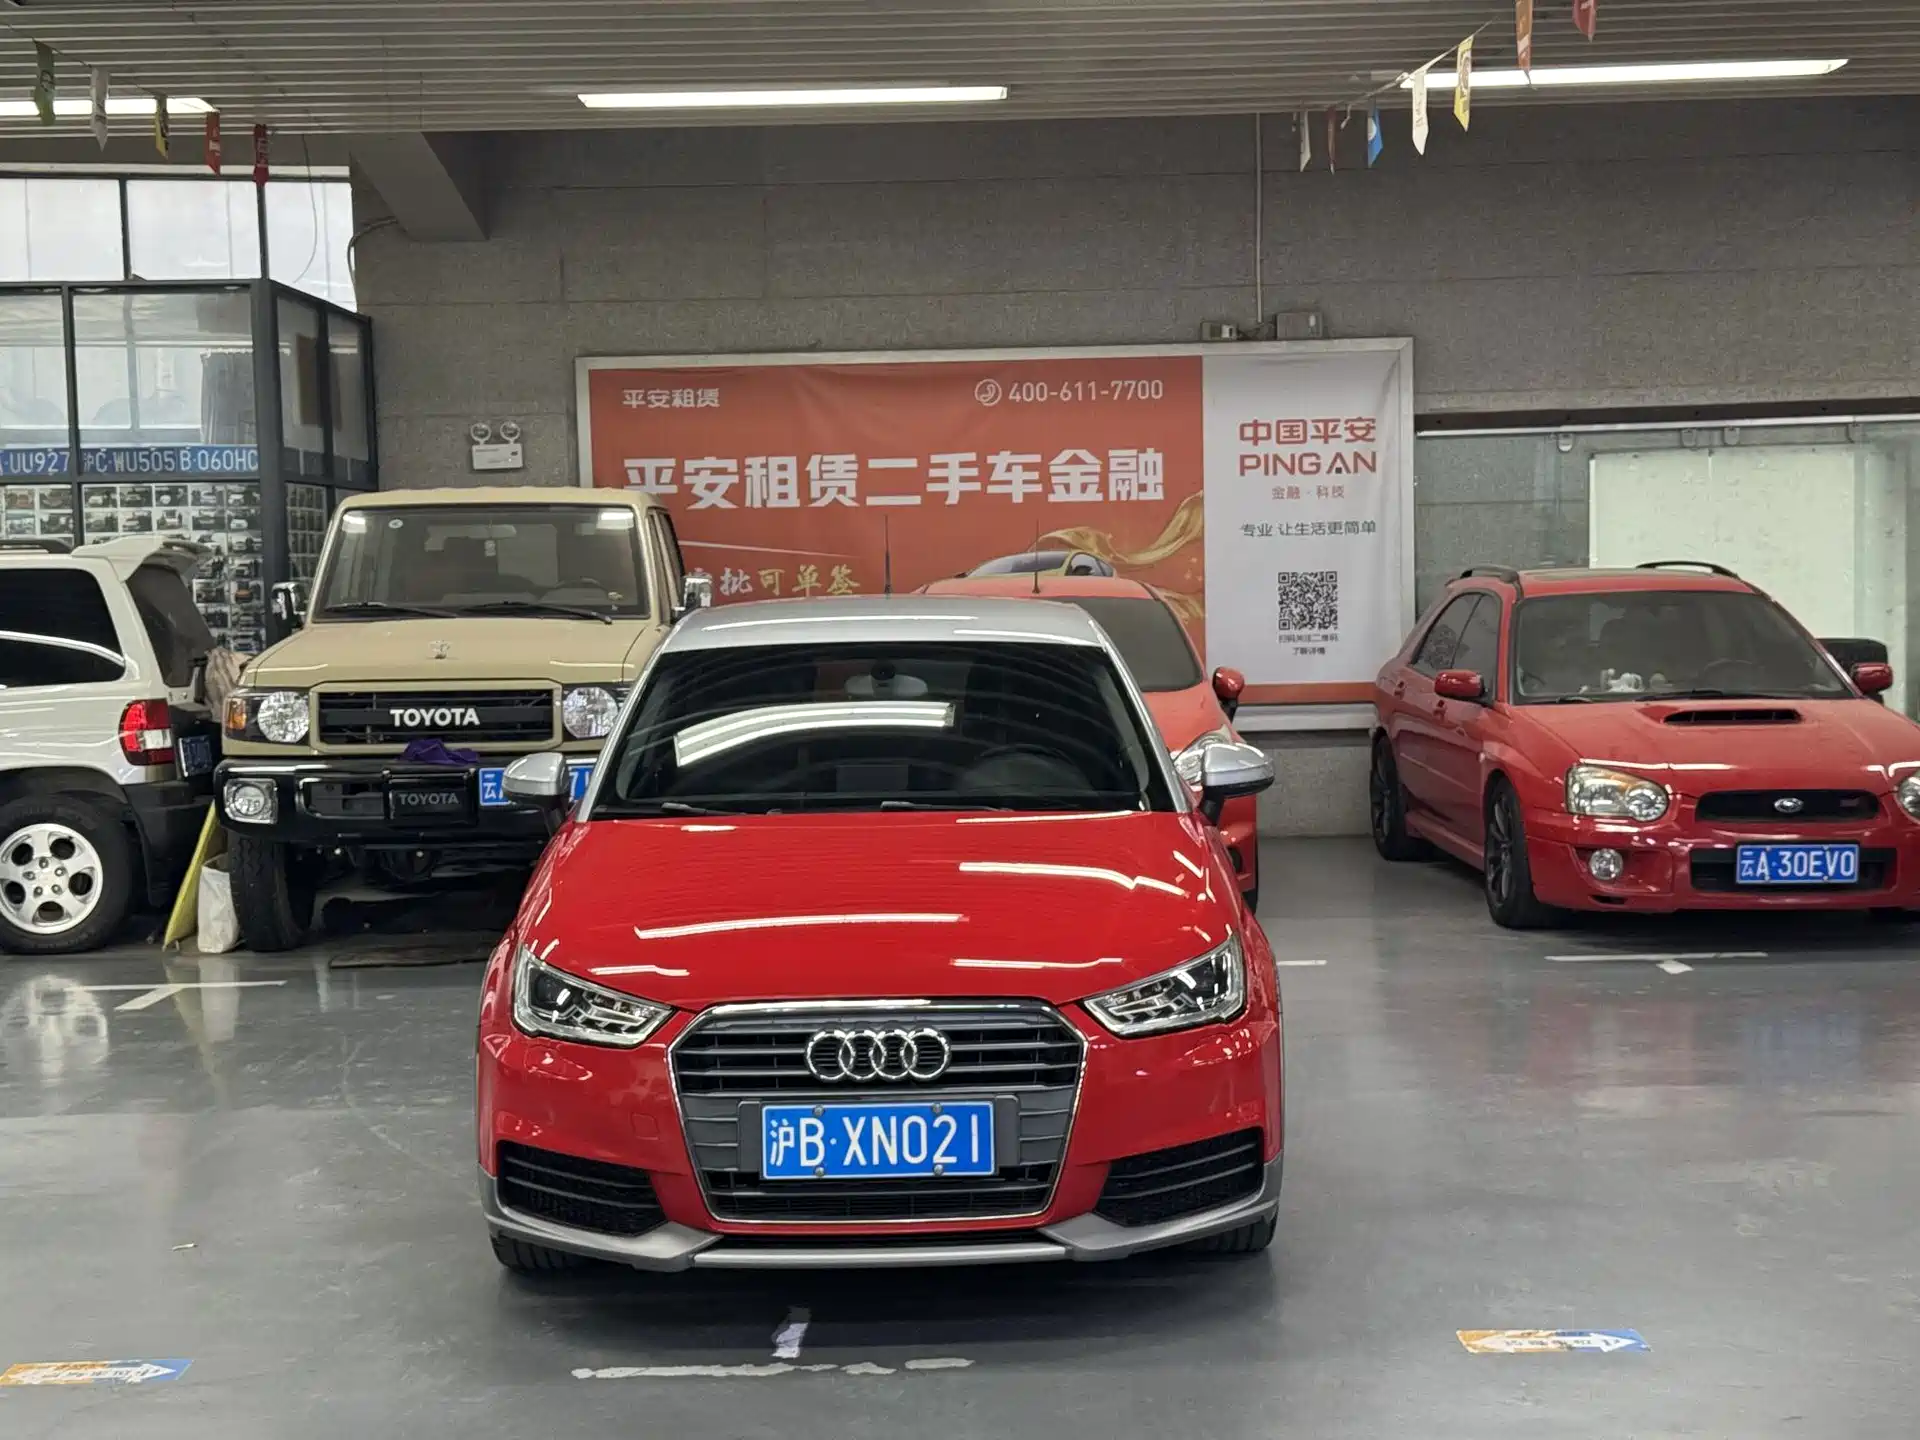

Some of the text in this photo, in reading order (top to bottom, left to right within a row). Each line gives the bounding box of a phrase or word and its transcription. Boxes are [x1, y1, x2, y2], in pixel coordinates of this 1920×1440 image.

[622, 388, 720, 409] 平安租赁
[1009, 379, 1163, 403] 400-611-7700
[1239, 417, 1377, 446] 中国平安
[623, 446, 1165, 510] 平安租赁二手车金融
[1278, 520, 1376, 537] 让生活更简单
[389, 707, 480, 727] TOYOTA
[399, 793, 459, 805] TOYOTA
